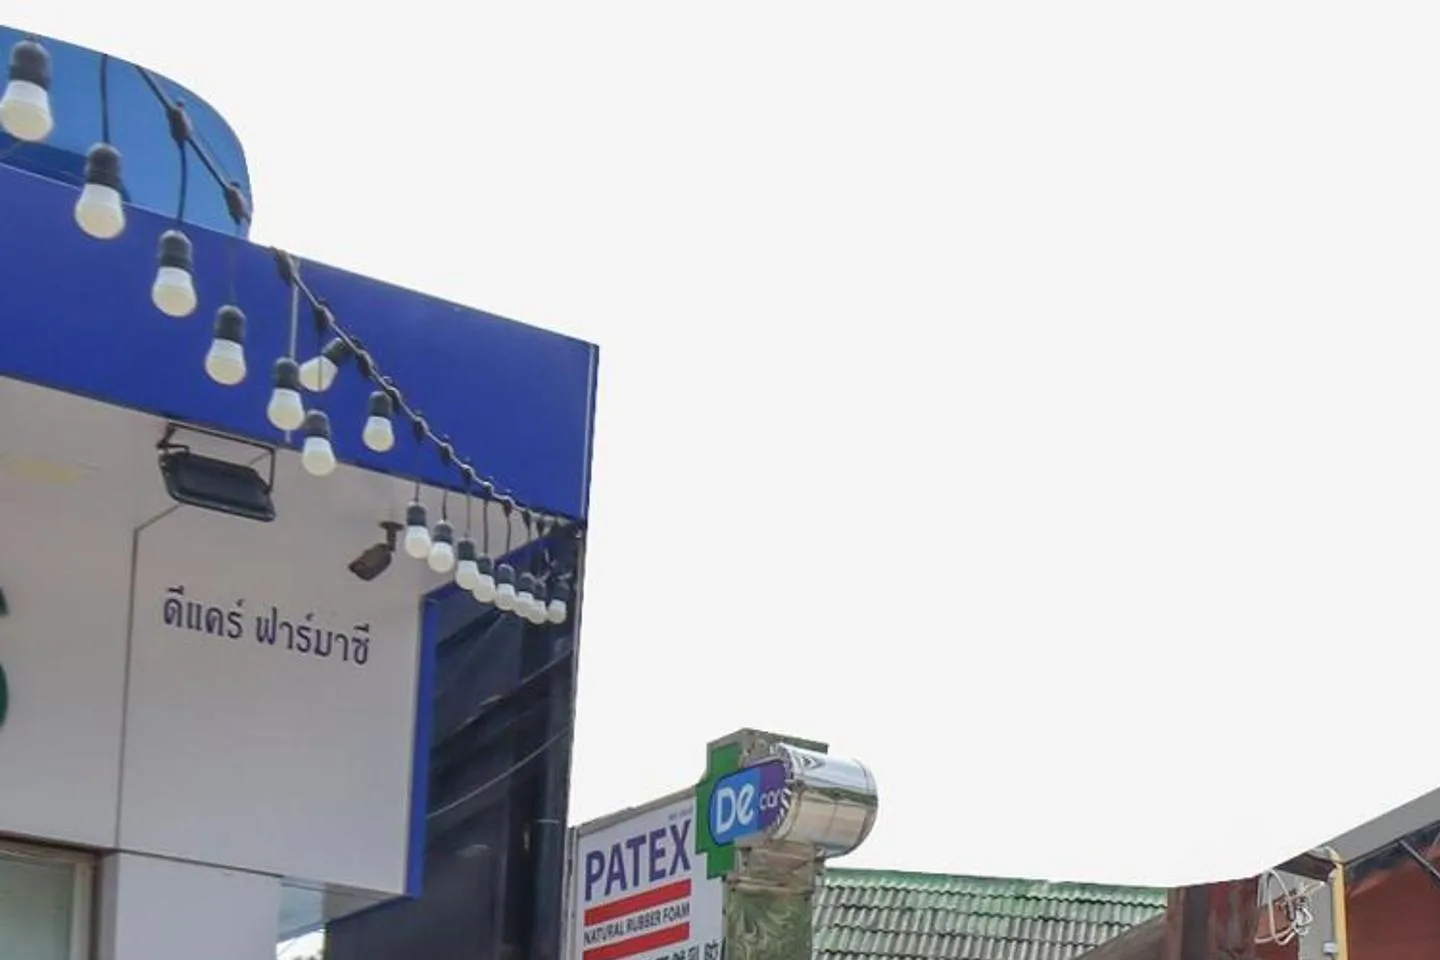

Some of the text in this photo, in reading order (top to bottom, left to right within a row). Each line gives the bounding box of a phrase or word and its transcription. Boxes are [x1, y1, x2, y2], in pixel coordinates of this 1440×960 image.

[163, 585, 246, 640] ดีแคร์
[716, 783, 755, 834] De
[584, 819, 692, 901] PATEX
[584, 902, 690, 945] NATURAL RUBBER FOAM
